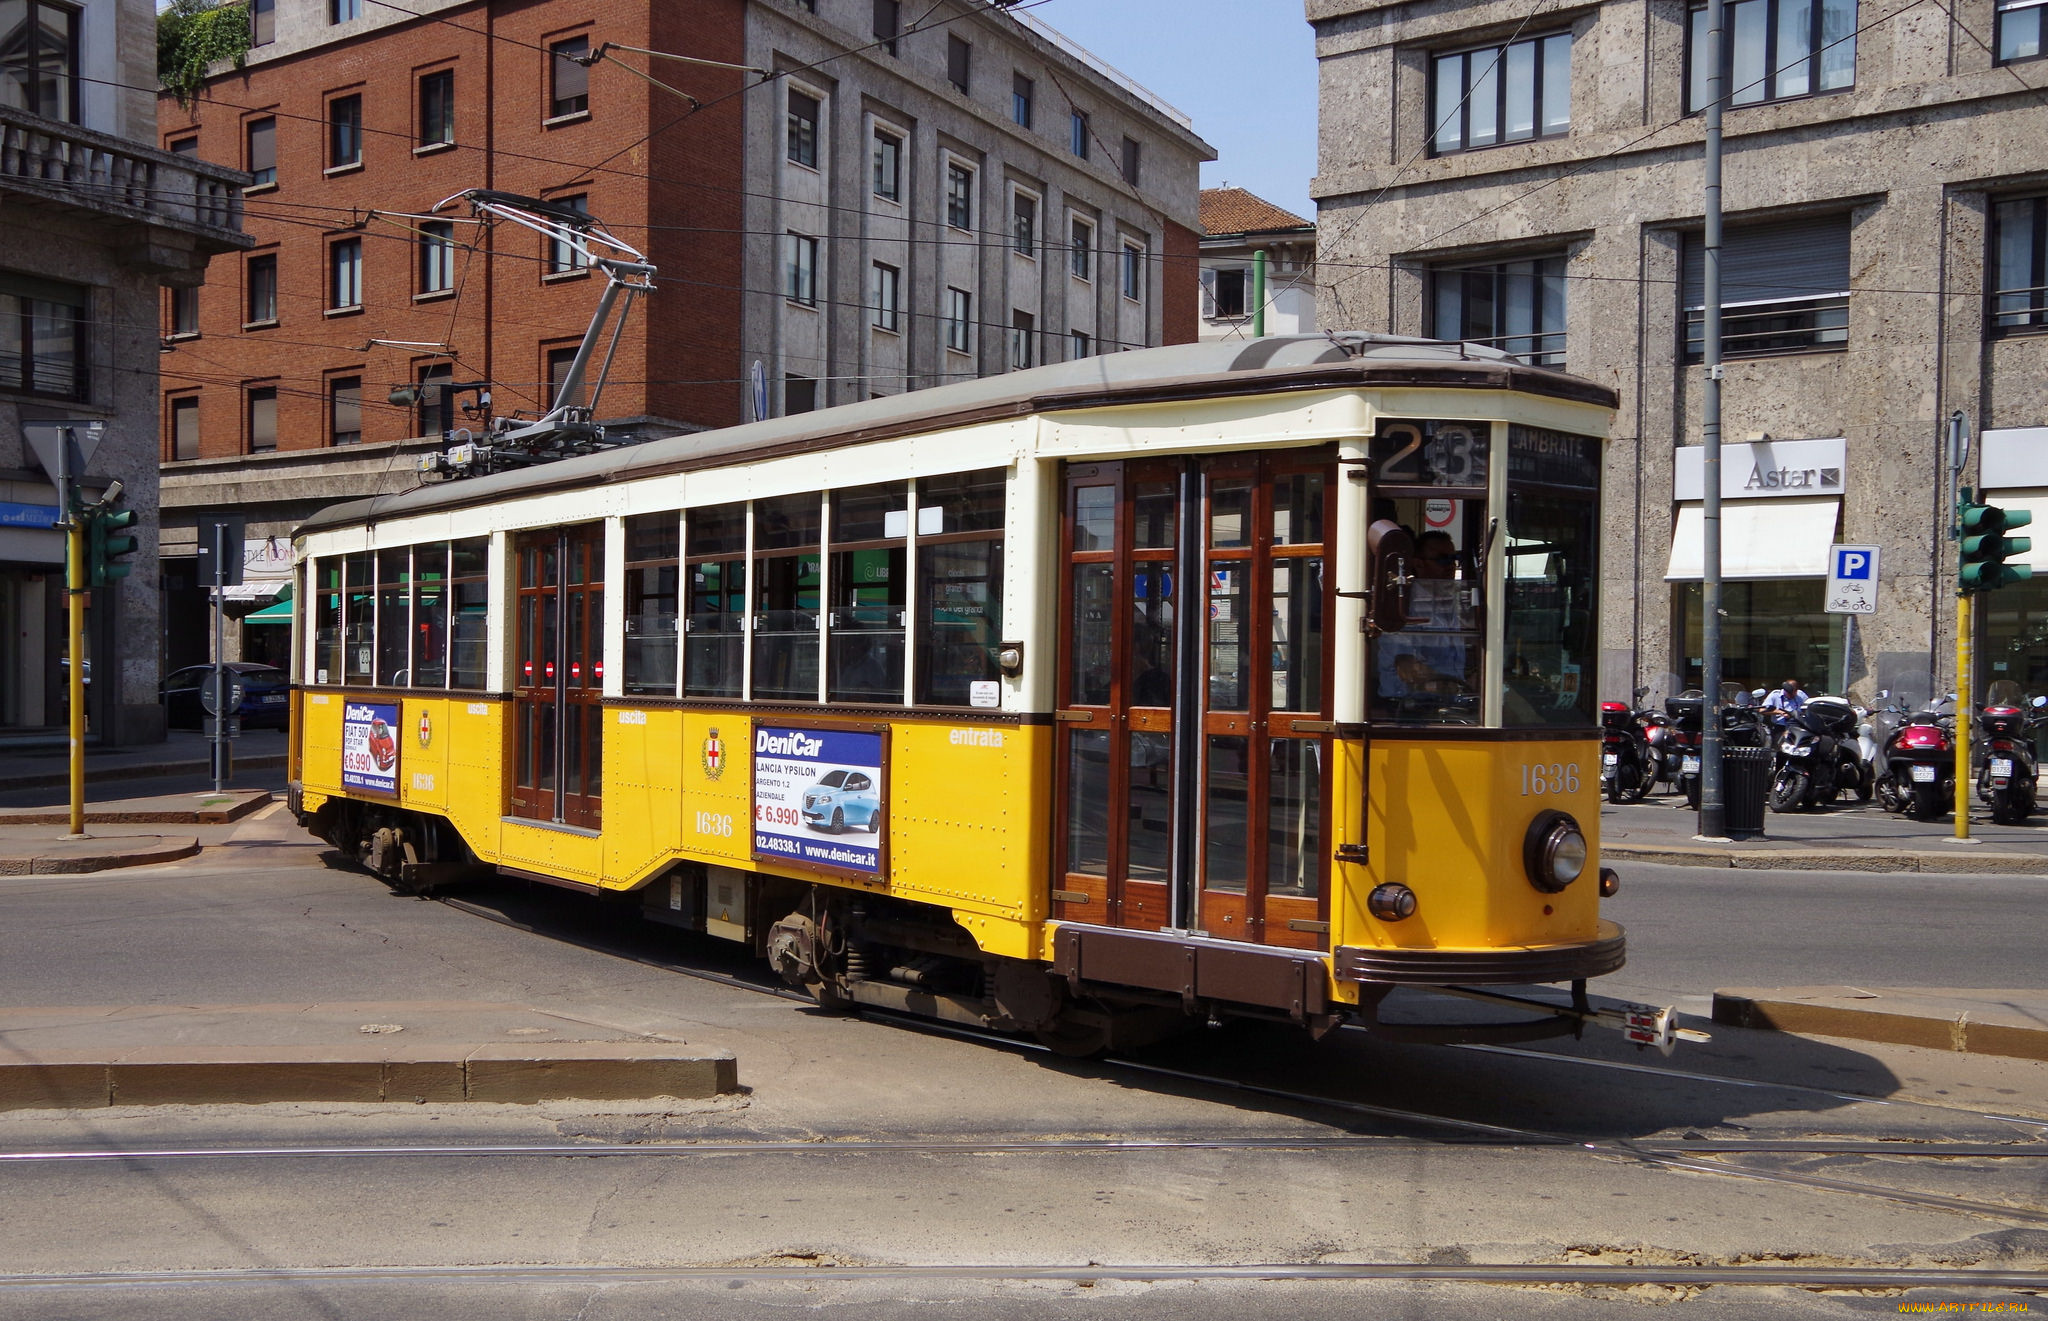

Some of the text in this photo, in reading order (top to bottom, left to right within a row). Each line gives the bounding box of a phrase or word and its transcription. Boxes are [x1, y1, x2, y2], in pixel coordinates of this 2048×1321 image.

[1511, 427, 1584, 458] LAMBRATE
[1743, 460, 1817, 490] Aster
[1844, 553, 1866, 576] P
[345, 705, 375, 721] DeniCar
[618, 709, 647, 725] uscita
[345, 725, 369, 738] FIAT 500
[949, 727, 1004, 748] entrata
[755, 730, 823, 757] DeniCar
[756, 762, 817, 777] LANCIA YPSILON
[1520, 763, 1580, 796] 1636
[413, 772, 435, 792] 1636
[756, 778, 790, 788] ARGENTO 1.2
[756, 792, 785, 801] AZIENDALE
[696, 810, 733, 838] 1636
[765, 805, 799, 826] 6.990
[756, 835, 876, 867] 02.48338.1 www.denicar.it
